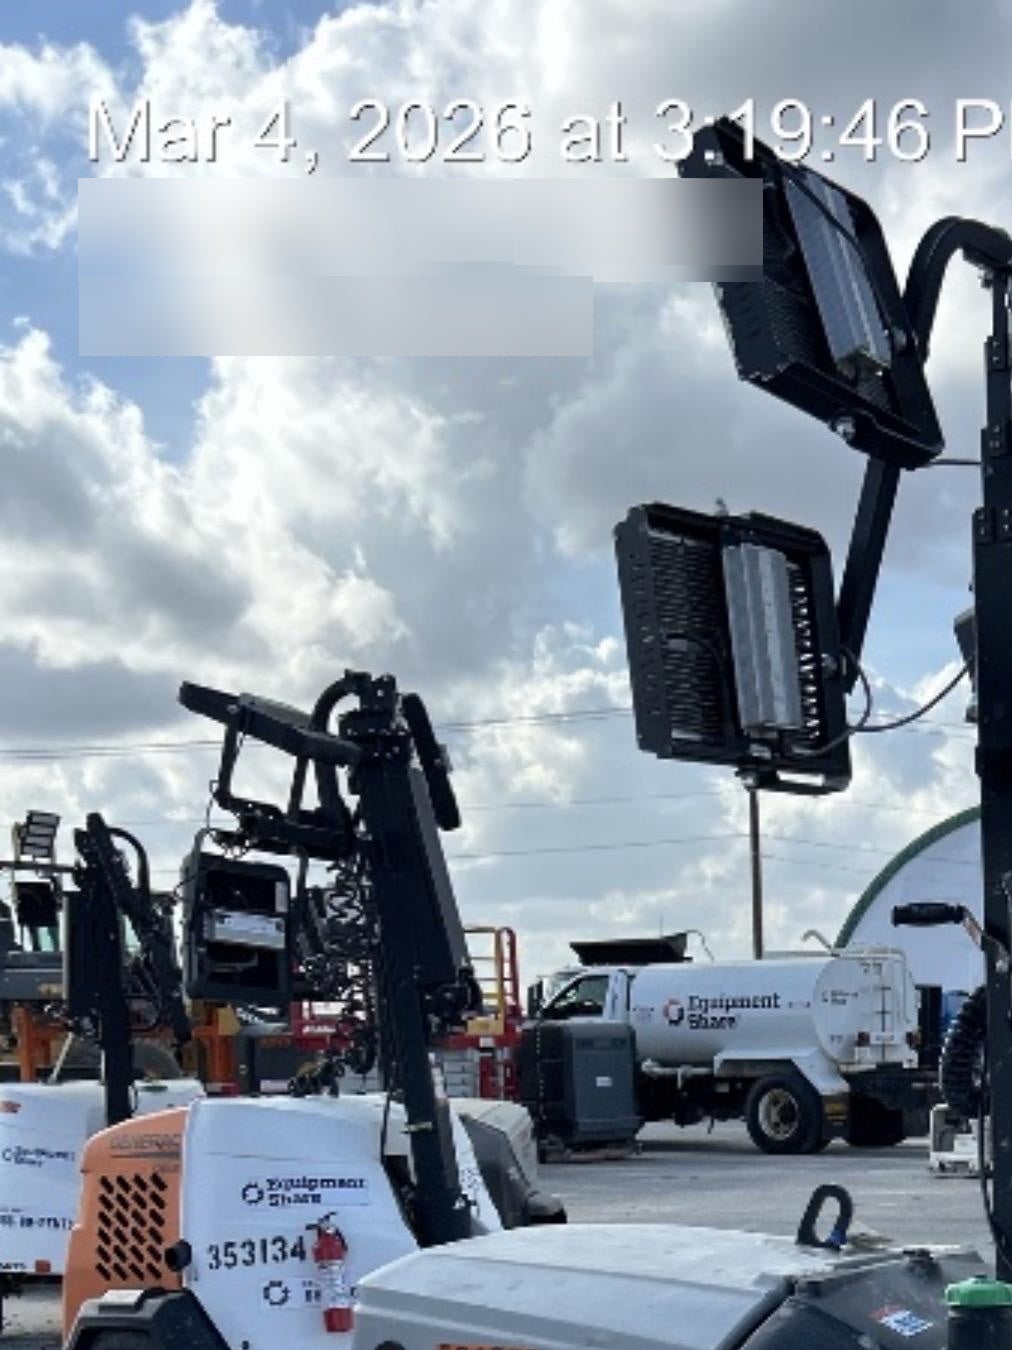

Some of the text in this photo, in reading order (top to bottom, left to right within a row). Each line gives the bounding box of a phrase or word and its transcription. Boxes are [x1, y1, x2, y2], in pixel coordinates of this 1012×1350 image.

[689, 993, 780, 1014] Equipment
[689, 1014, 737, 1030] Share
[266, 1177, 366, 1191] Equipment
[269, 1193, 321, 1206] Share
[209, 1237, 306, 1269] 353134
